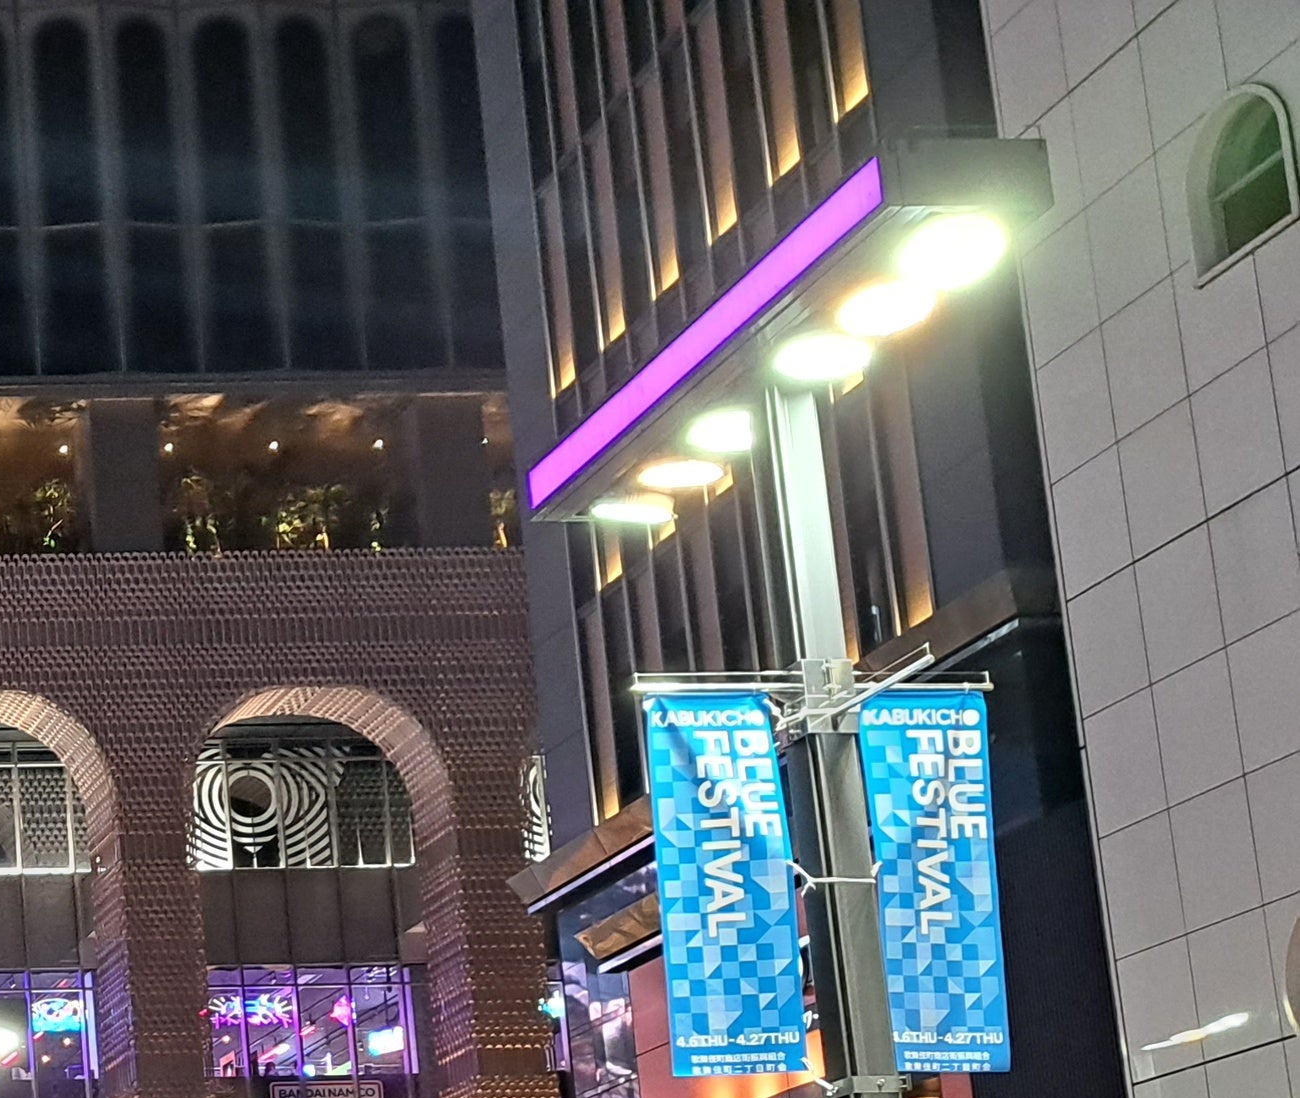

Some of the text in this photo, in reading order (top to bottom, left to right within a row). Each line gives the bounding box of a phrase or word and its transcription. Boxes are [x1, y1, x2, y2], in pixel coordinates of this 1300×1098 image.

[650, 708, 766, 728] KABUKICHO
[862, 708, 980, 727] KABUKICHO
[692, 730, 747, 938] FESTIVAL
[732, 729, 783, 838] BLUE
[905, 729, 953, 936] FESTIVAL
[946, 729, 989, 840] BLUE
